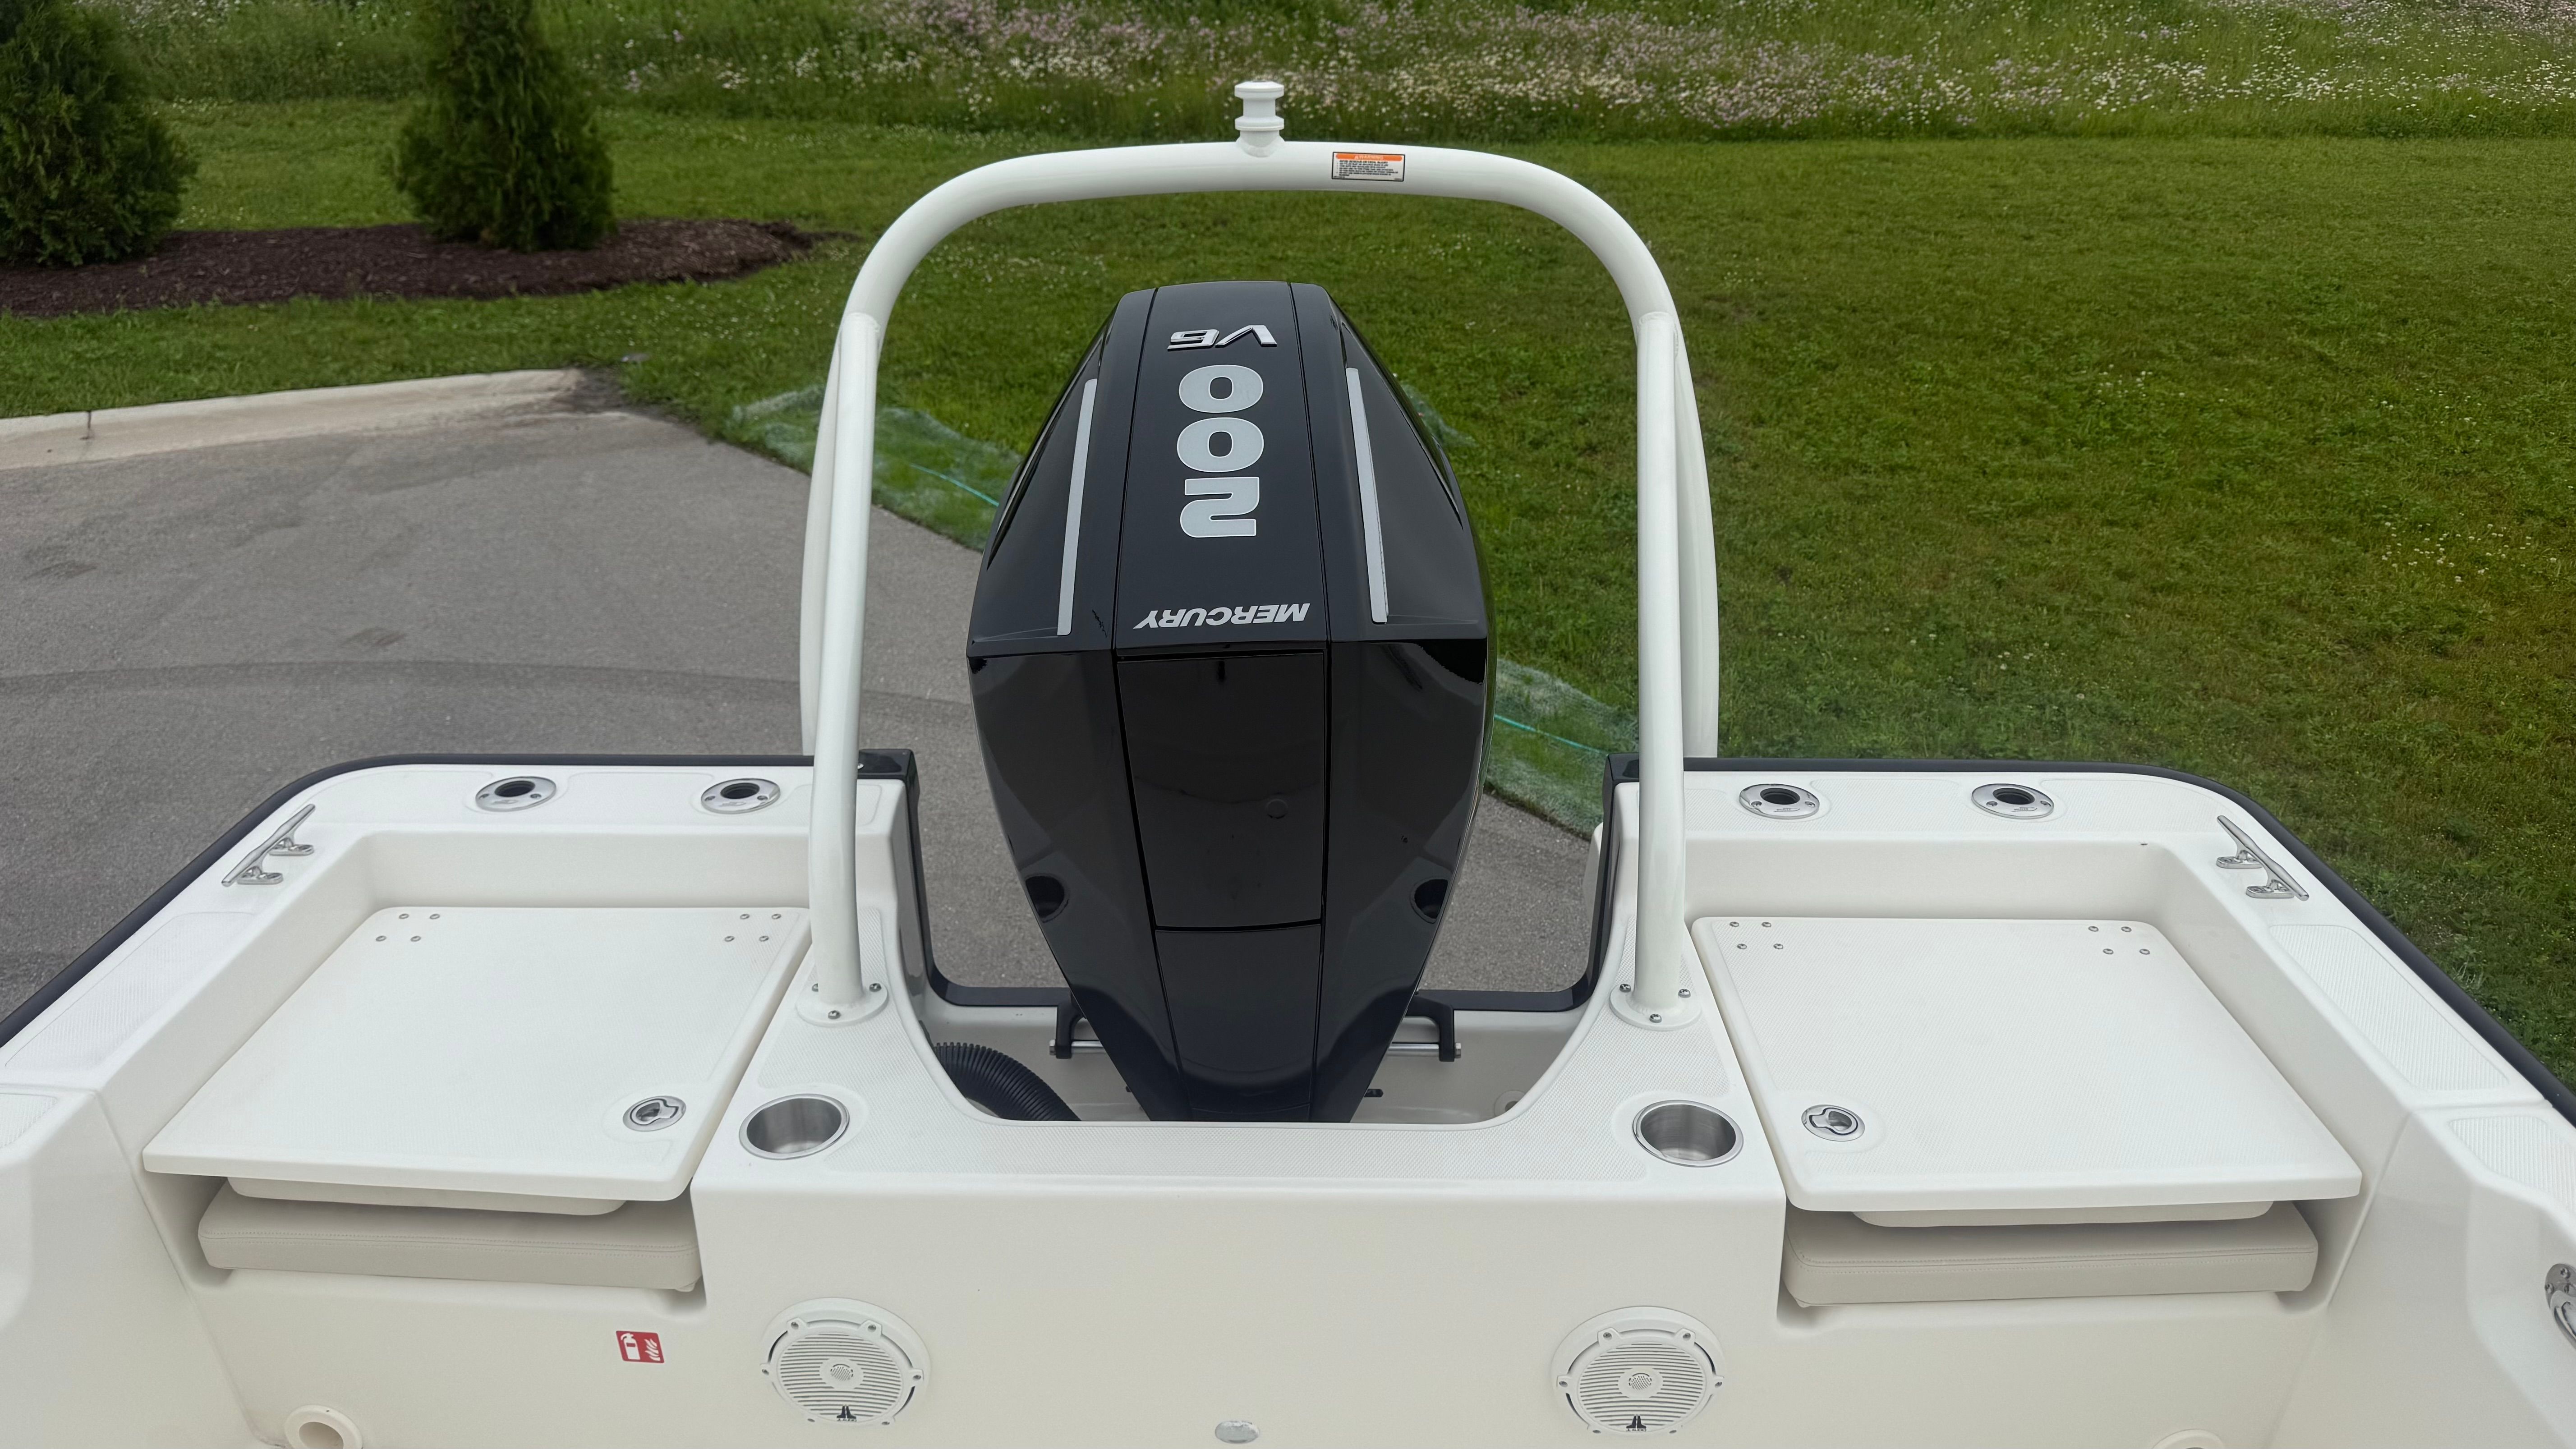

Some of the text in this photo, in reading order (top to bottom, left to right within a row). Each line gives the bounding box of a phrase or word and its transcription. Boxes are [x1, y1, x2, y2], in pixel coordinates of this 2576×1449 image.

[1167, 325, 1278, 351] V6
[1177, 364, 1264, 538] 200
[1132, 603, 1311, 629] MERCURY
